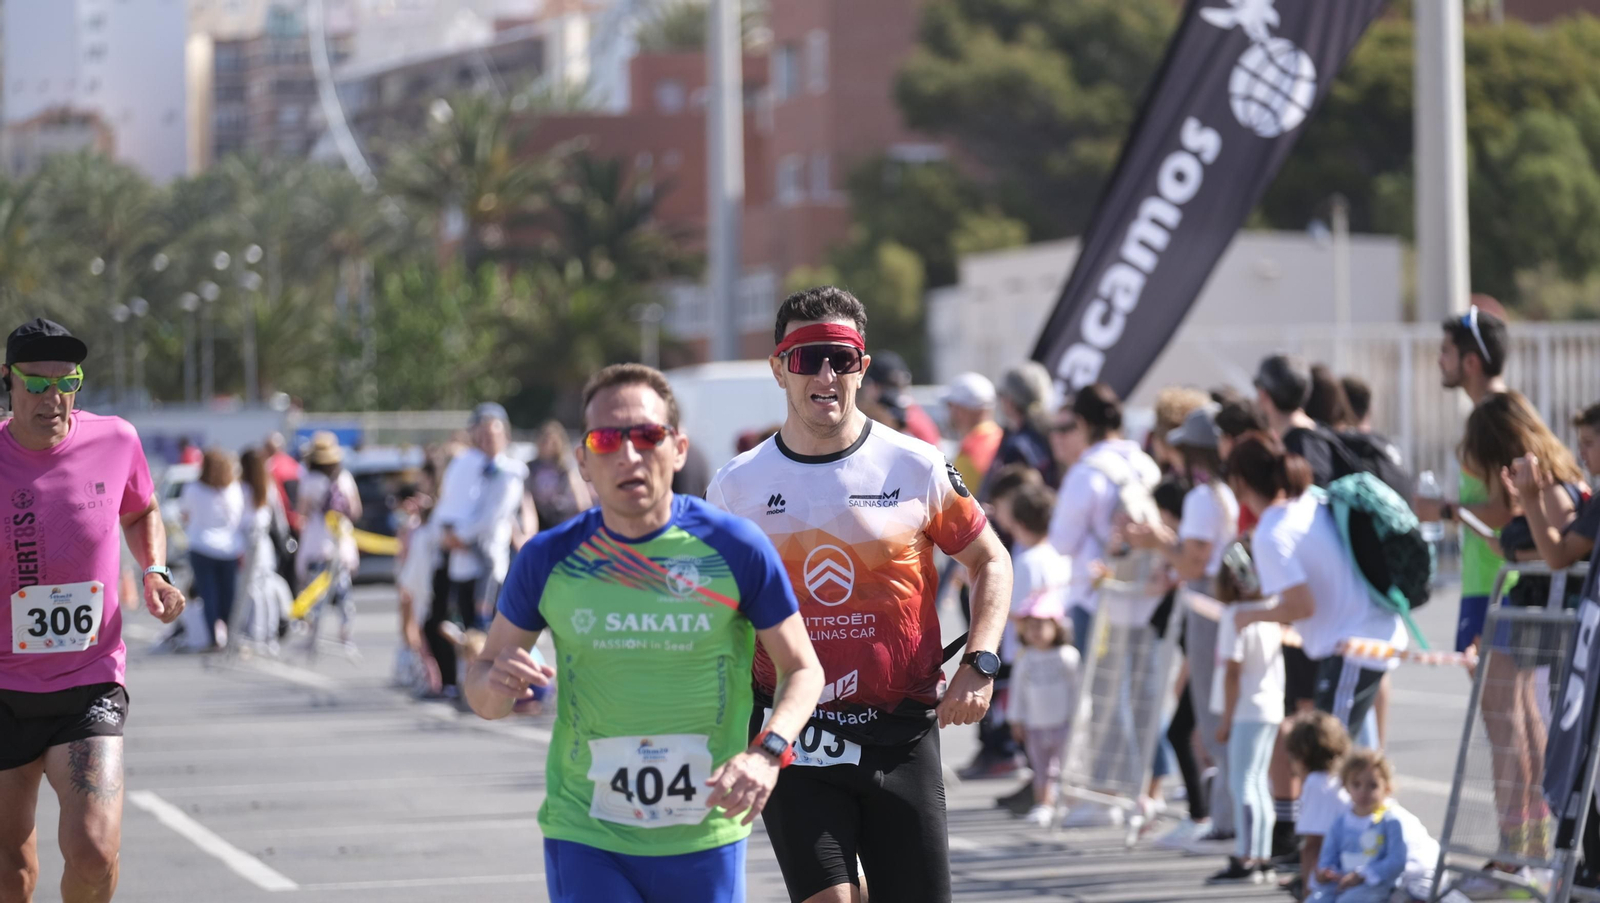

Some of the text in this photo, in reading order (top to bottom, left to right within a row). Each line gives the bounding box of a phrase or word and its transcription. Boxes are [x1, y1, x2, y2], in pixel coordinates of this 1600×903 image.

[1055, 116, 1223, 396] acamos
[78, 498, 113, 510] 2019
[766, 507, 786, 515] mobel
[848, 499, 899, 508] SALINAS CAR
[4, 516, 12, 550] NADO
[13, 512, 39, 589] UERT8S
[27, 604, 93, 637] 306
[605, 612, 711, 633] SAKATA
[810, 627, 875, 641] LINAS CAR
[651, 639, 661, 649] in
[664, 639, 693, 651] Seed
[792, 723, 846, 758] 03
[610, 763, 697, 806] 404
